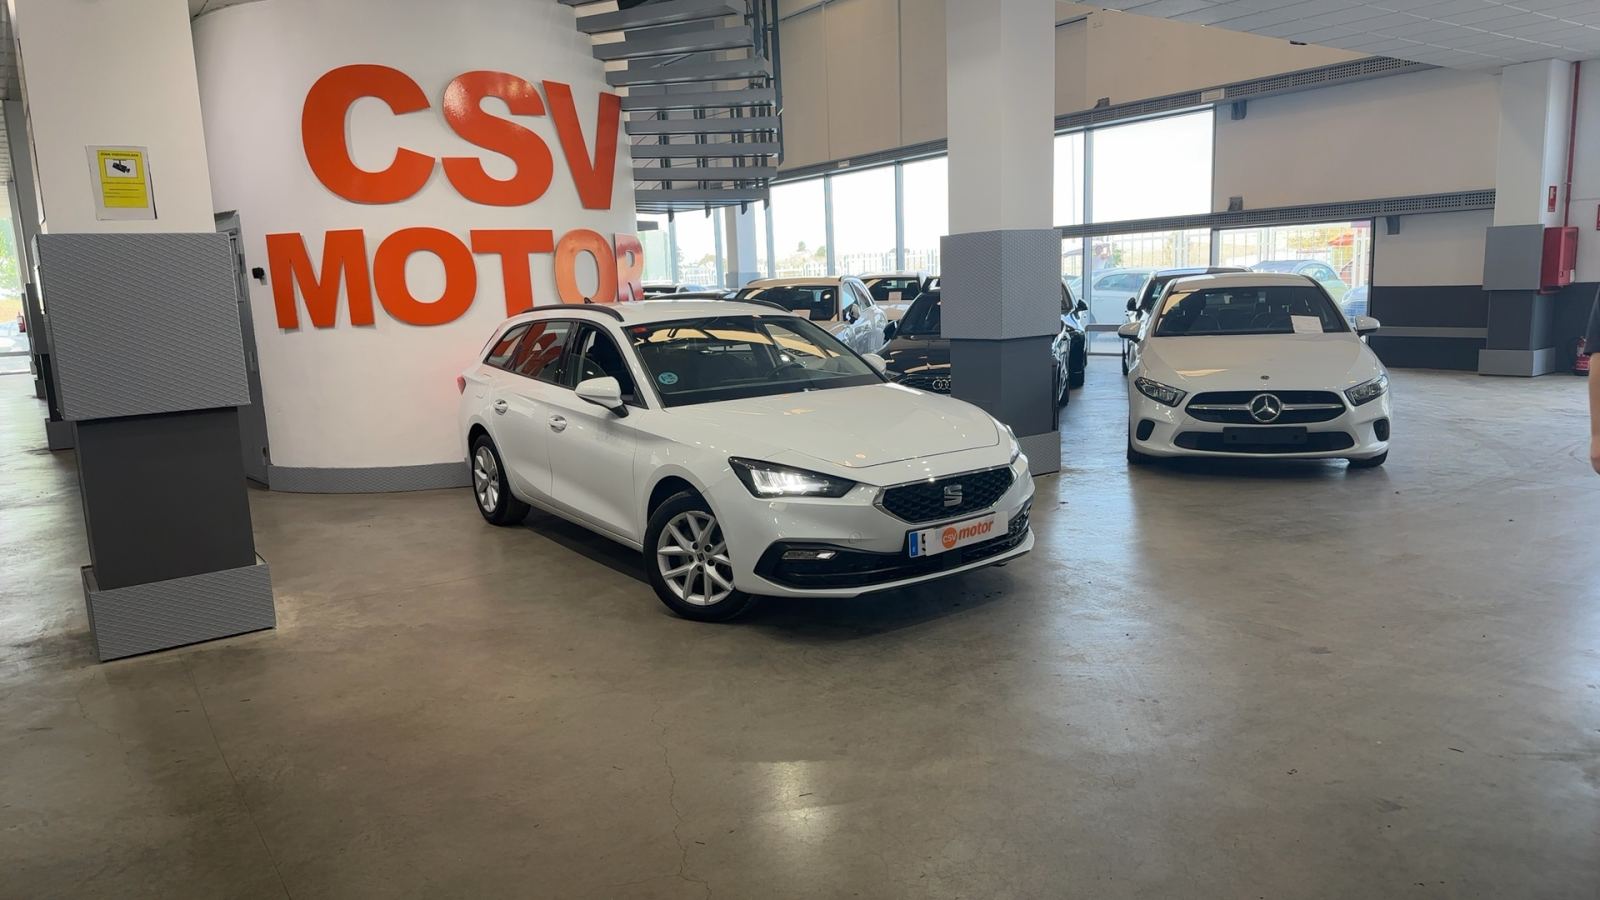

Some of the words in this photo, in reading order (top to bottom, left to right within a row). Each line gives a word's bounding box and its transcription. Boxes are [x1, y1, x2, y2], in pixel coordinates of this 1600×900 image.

[302, 64, 622, 210] CSV
[266, 227, 643, 329] MOTOR
[959, 520, 993, 540] motor
